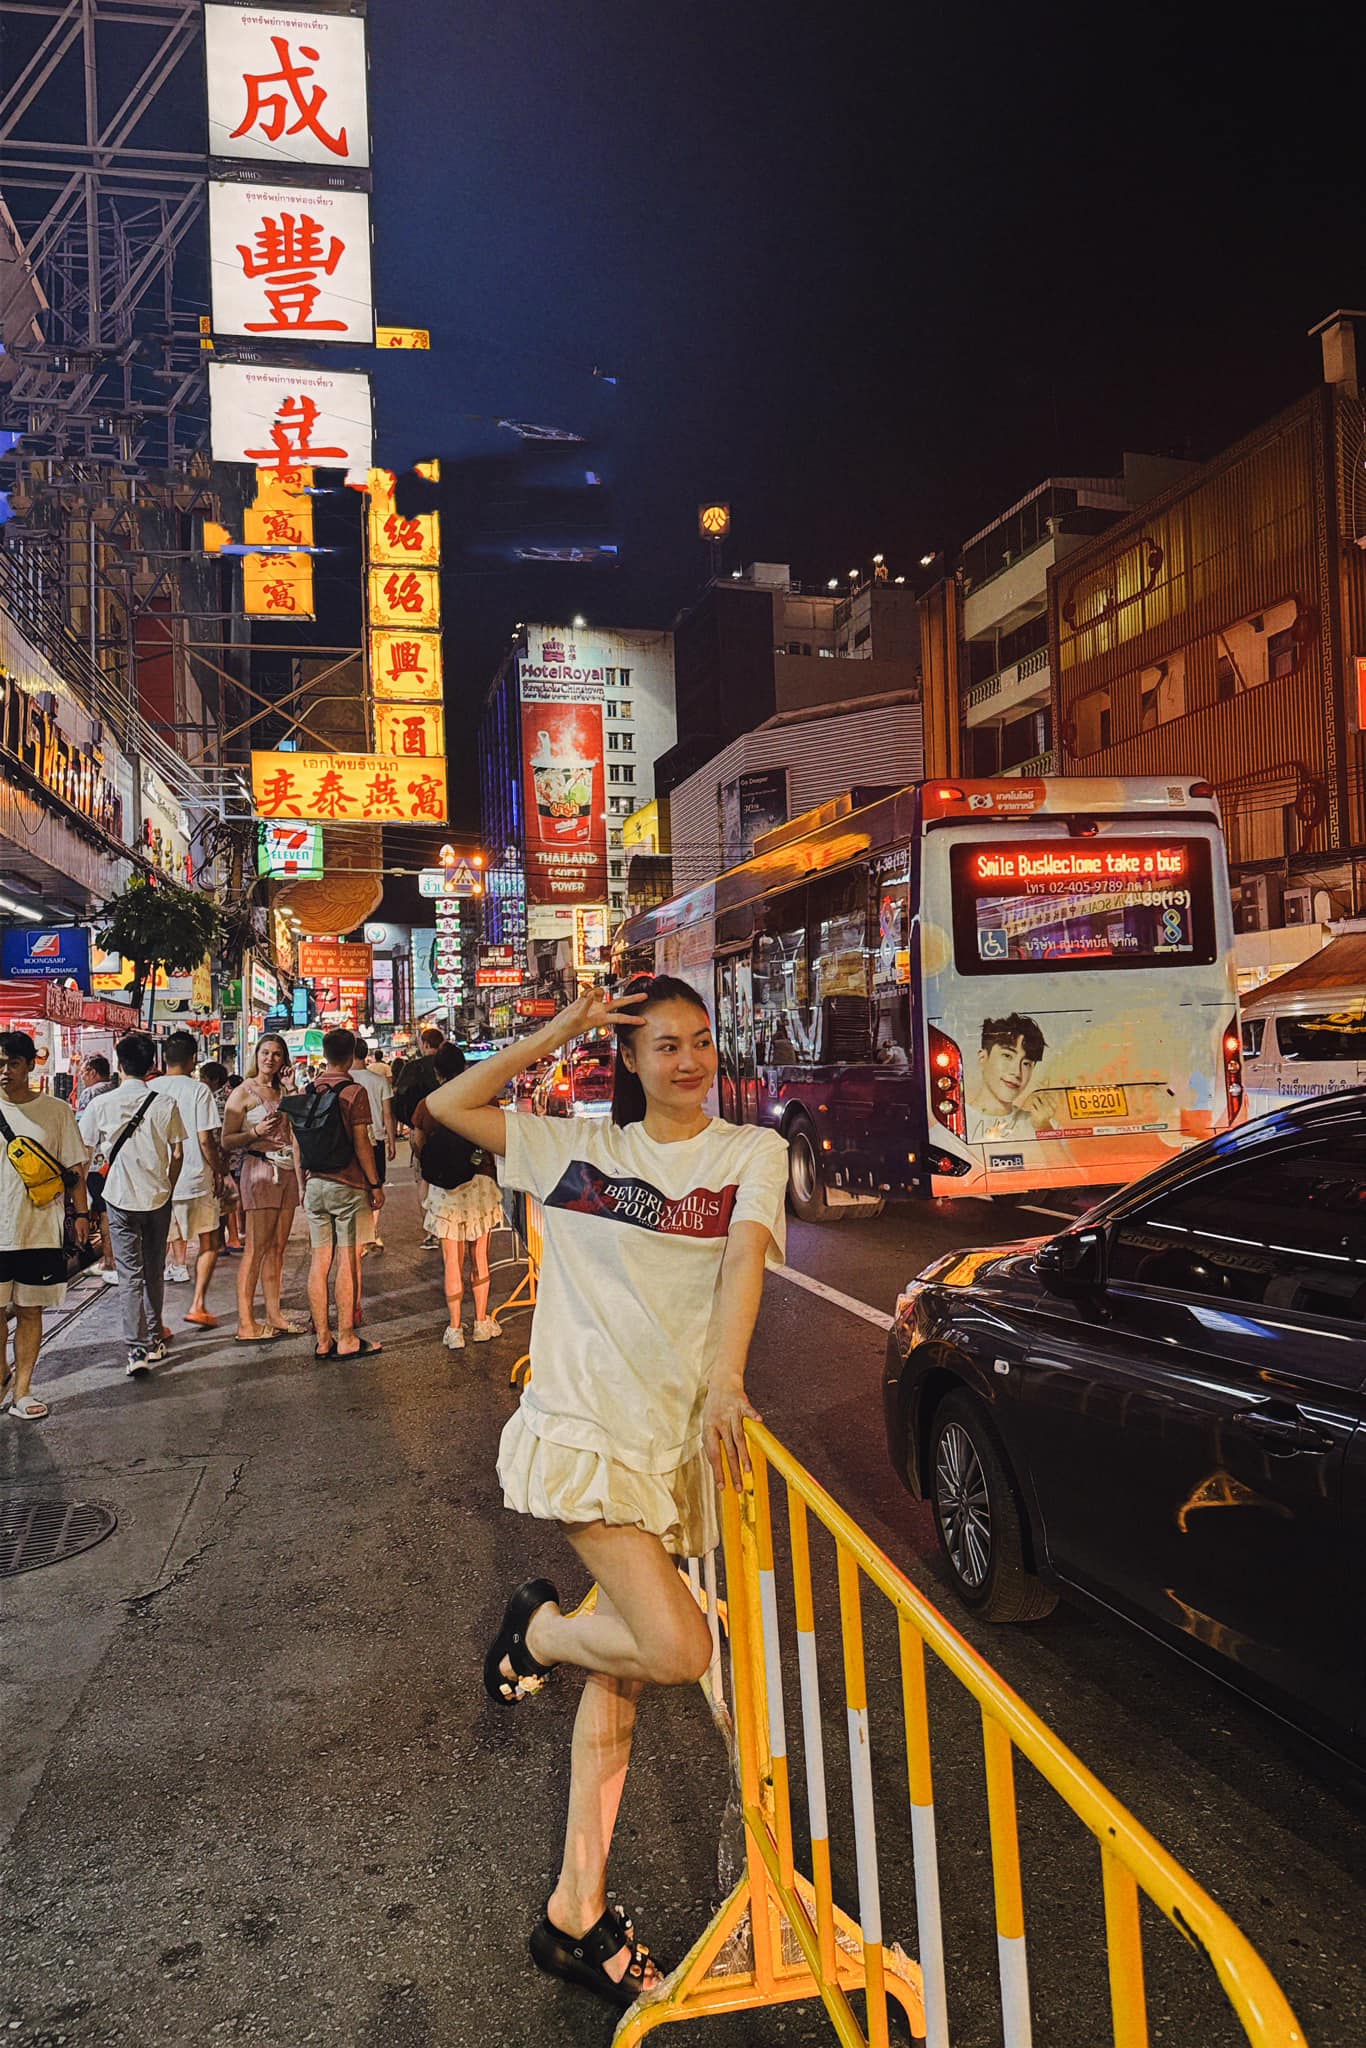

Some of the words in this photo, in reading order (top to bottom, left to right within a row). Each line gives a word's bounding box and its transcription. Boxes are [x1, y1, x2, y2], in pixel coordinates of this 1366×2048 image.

[229, 35, 350, 157] 成
[536, 852, 599, 864] THAILAND
[977, 855, 1015, 877] Smile
[1105, 852, 1141, 873] take
[1143, 855, 1154, 871] a
[1156, 850, 1182, 871] bus
[551, 881, 585, 892] POWER
[1024, 879, 1045, 894] โทร
[1049, 880, 1123, 893] 02-405-9789
[1026, 936, 1056, 951] บริษัท
[1060, 934, 1109, 949] สมาร์ทบัส
[1111, 931, 1139, 948] จำกัด
[1073, 1093, 1121, 1110] 16-8201
[604, 1184, 677, 1217] BEVERLY
[613, 1200, 660, 1226] POLO
[660, 1208, 704, 1231] CLUB
